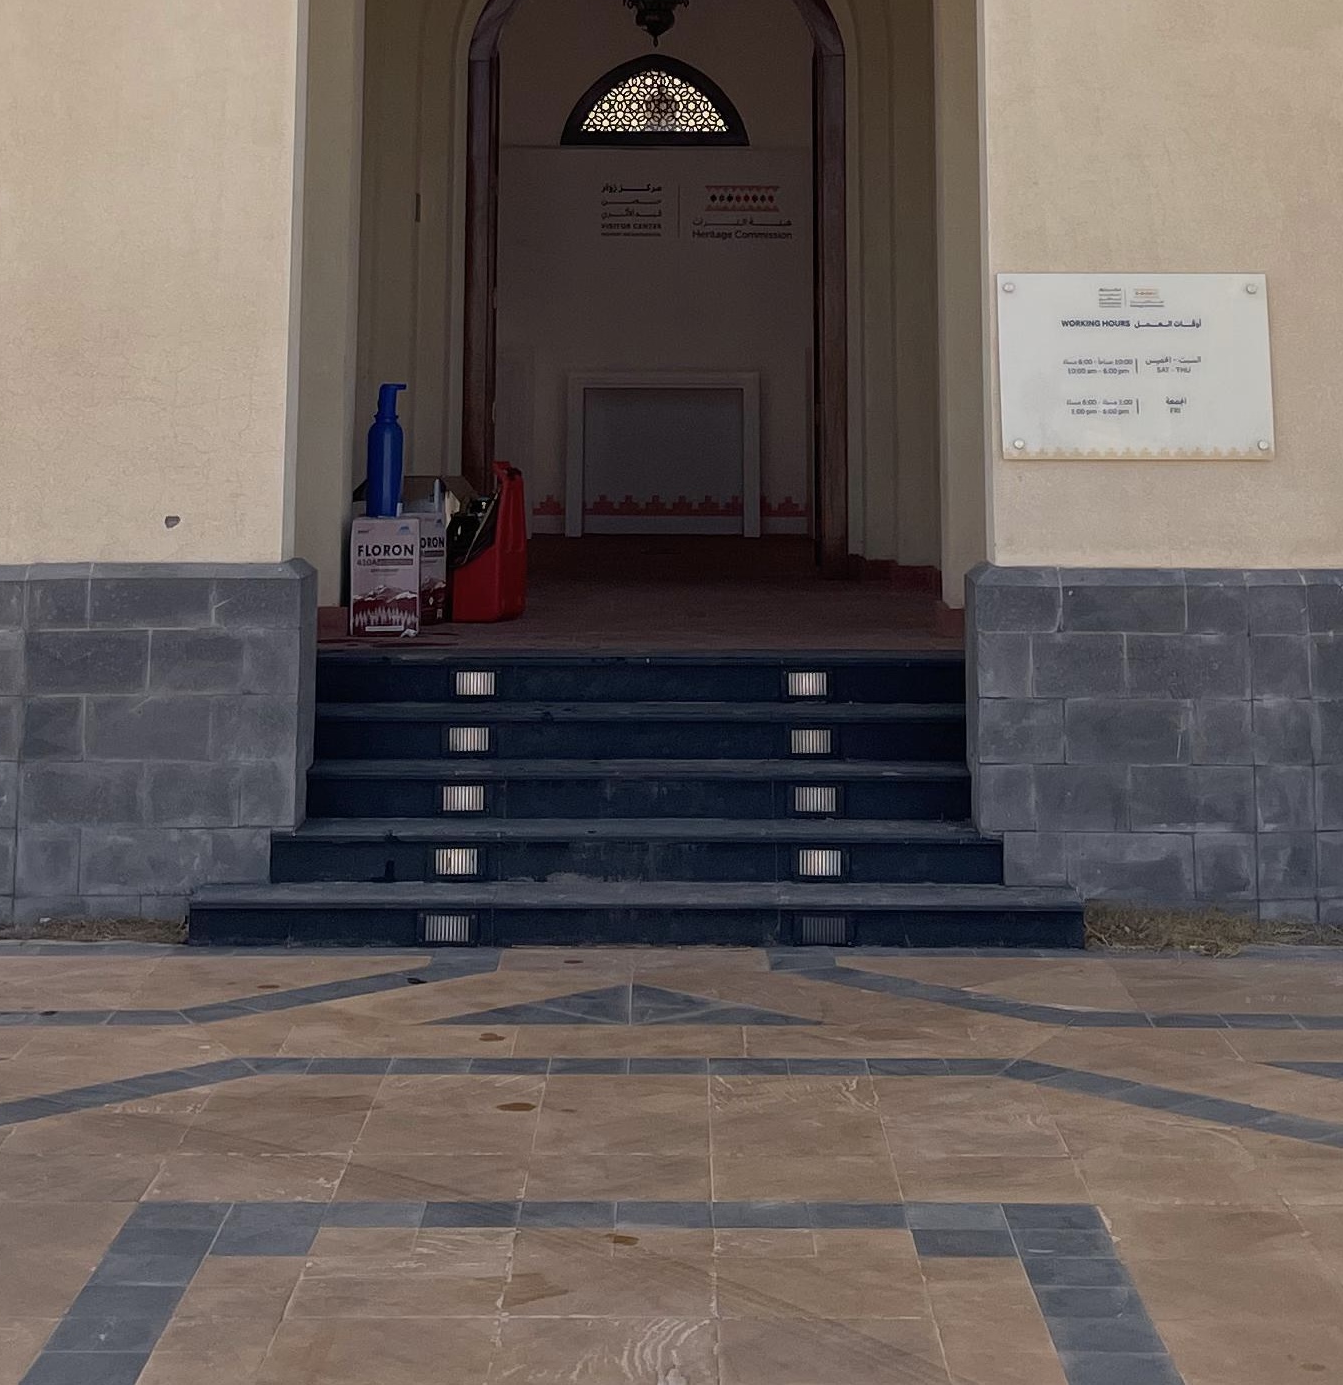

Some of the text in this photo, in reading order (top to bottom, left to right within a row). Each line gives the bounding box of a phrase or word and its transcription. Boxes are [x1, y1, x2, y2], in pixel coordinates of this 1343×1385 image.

[692, 230, 792, 240] Heritage Commission
[1061, 319, 1131, 328] WORKING HOURS
[357, 544, 414, 557] FLORON
